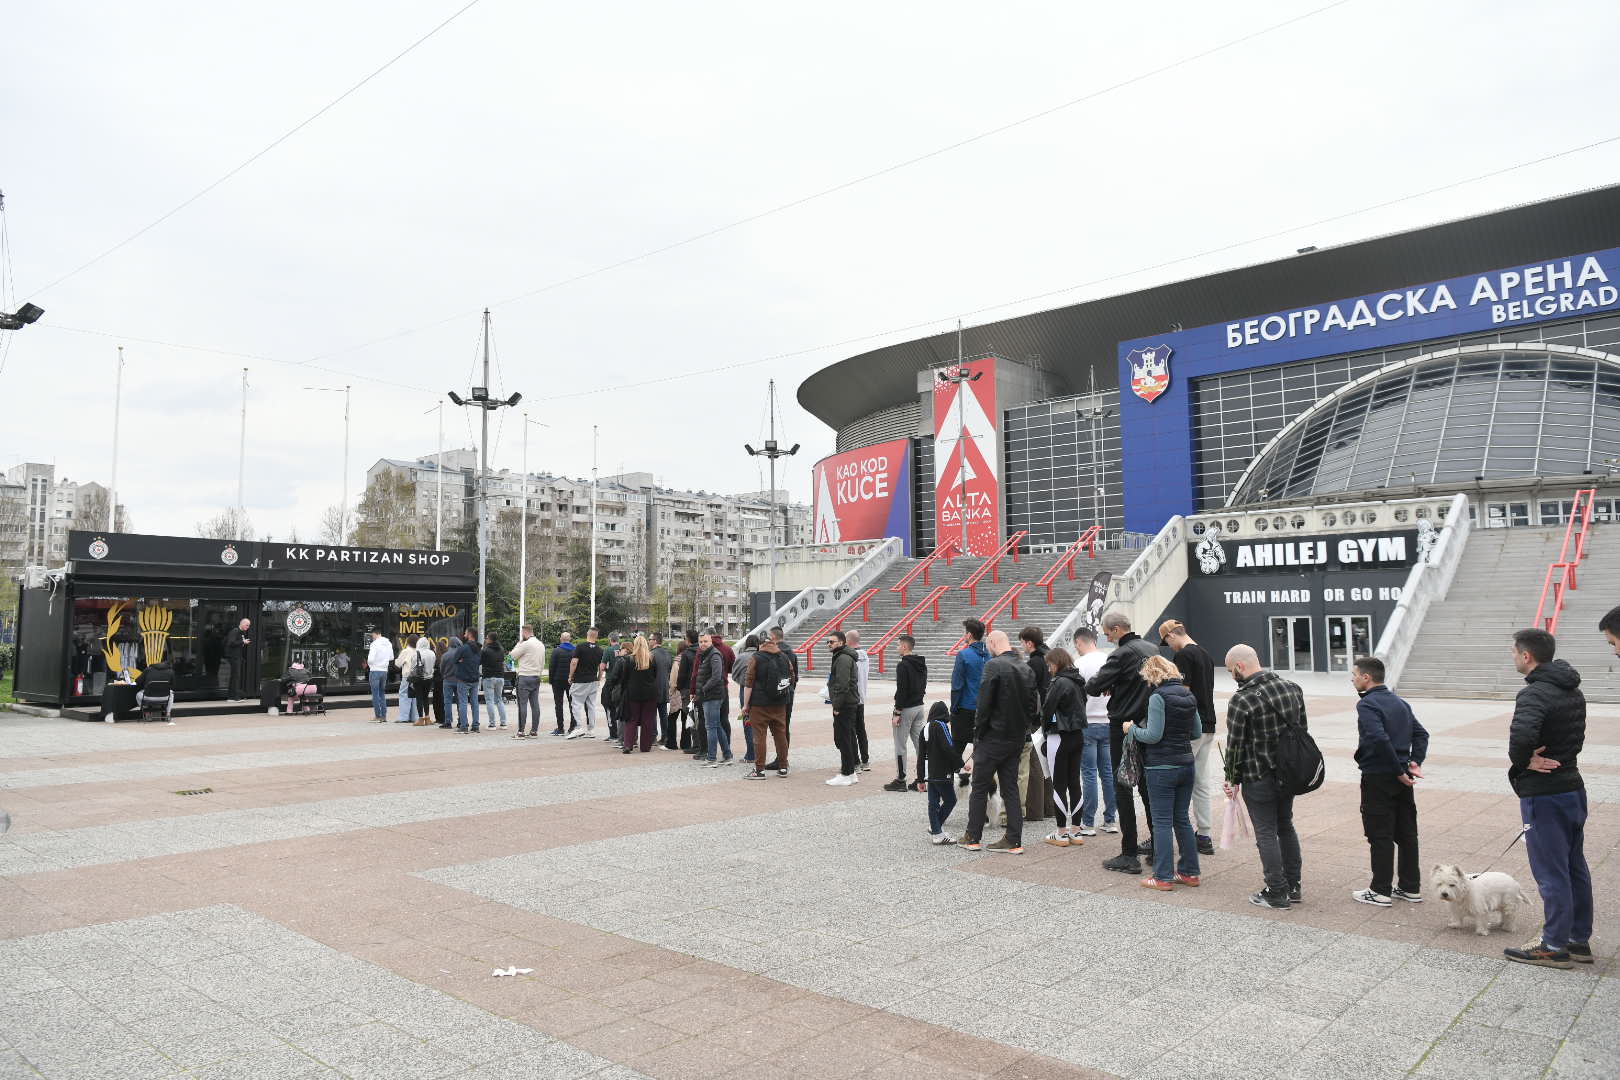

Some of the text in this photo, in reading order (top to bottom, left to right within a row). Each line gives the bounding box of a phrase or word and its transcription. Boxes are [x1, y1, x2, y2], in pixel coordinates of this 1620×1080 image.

[1226, 256, 1609, 348] БЕОГРАДСКА АРЕНА
[1491, 286, 1618, 323] BELGRAD
[836, 456, 888, 480] KAO KOD
[942, 491, 992, 509] ALTA
[286, 547, 451, 566] KK PARTIZAN SHOP
[1235, 536, 1407, 568] AHILEJ GYM
[1223, 590, 1266, 604] TRAIN
[1270, 589, 1312, 603] HARD
[1323, 588, 1345, 602] OR
[1350, 587, 1373, 601] GO
[399, 604, 457, 618] SLAVNO
[399, 621, 425, 634] IME
